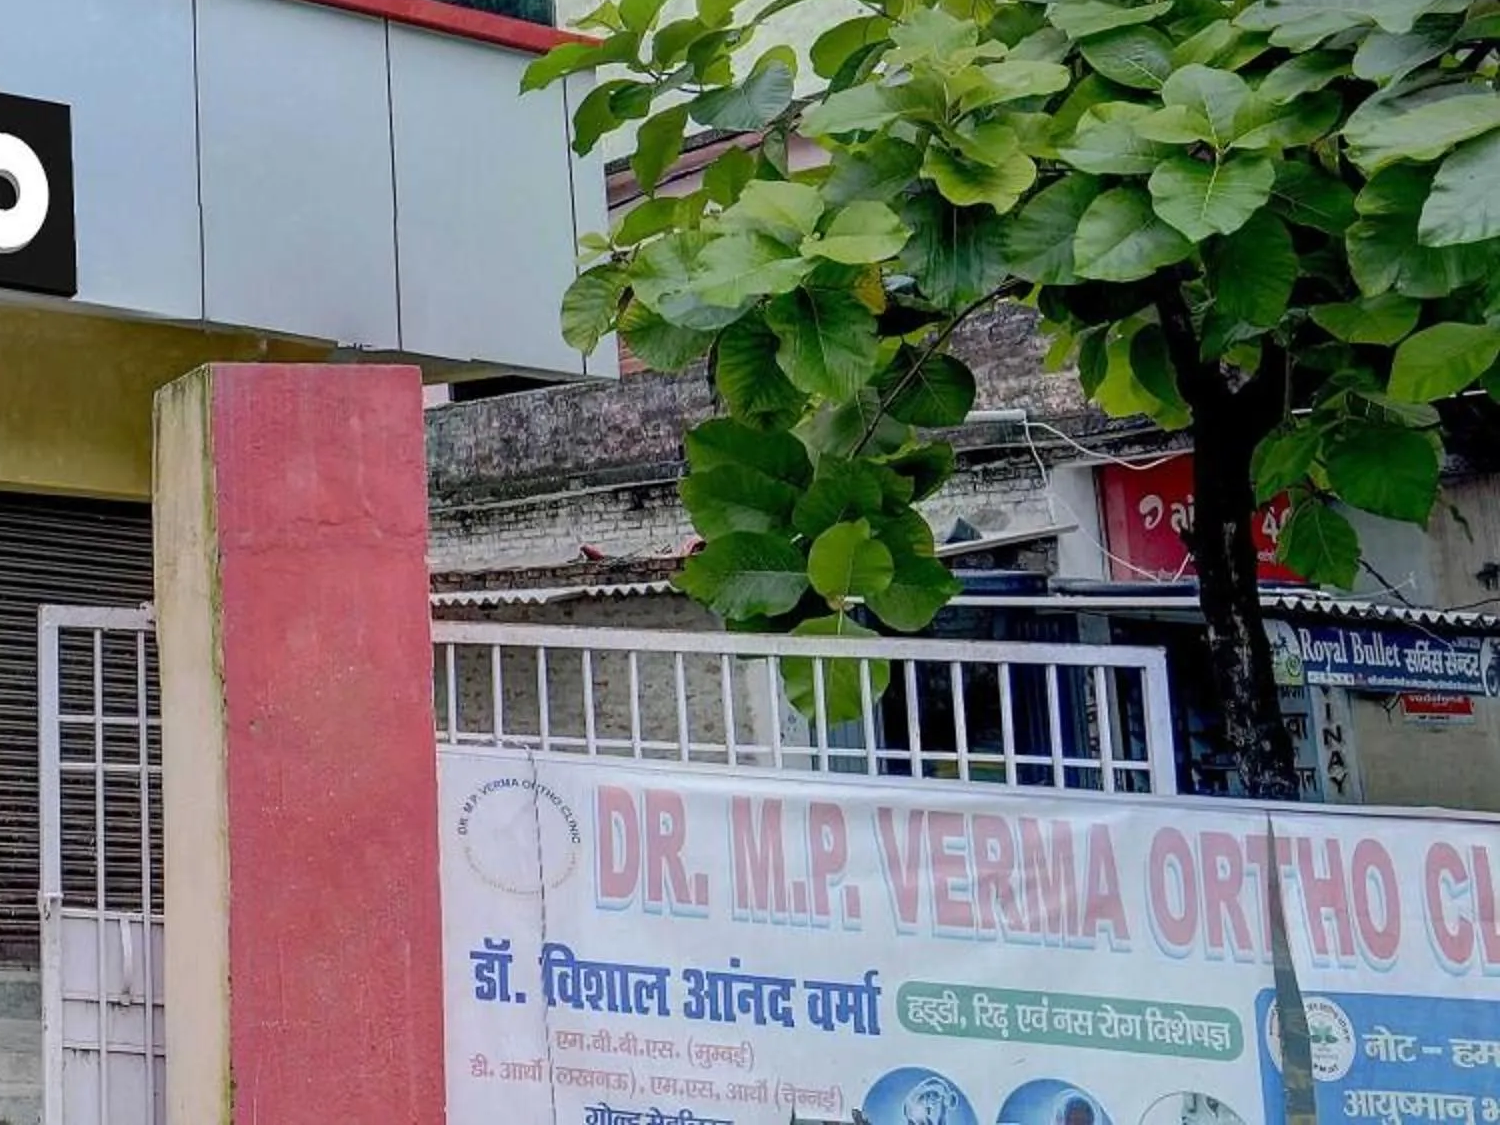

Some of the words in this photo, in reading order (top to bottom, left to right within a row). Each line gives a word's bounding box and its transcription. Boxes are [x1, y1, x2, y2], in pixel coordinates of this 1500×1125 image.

[1298, 627, 1349, 673] Royal
[1350, 631, 1401, 668] Bullet
[478, 778, 520, 796] VERMA
[560, 804, 581, 844] CLINIC
[595, 785, 709, 915] DR.
[730, 795, 862, 927] M.P.
[876, 807, 1132, 947] VERMA
[1148, 826, 1400, 970] ORTHO
[470, 938, 527, 1004] डॉ.
[539, 942, 671, 1016] विशाल
[803, 970, 882, 1036] वर्मा
[1016, 996, 1049, 1033] एवं
[1052, 1008, 1094, 1037] नस
[1097, 1004, 1142, 1041] रोग
[1145, 1007, 1231, 1052] विशेषज्ञ
[1361, 1025, 1418, 1063] नोट
